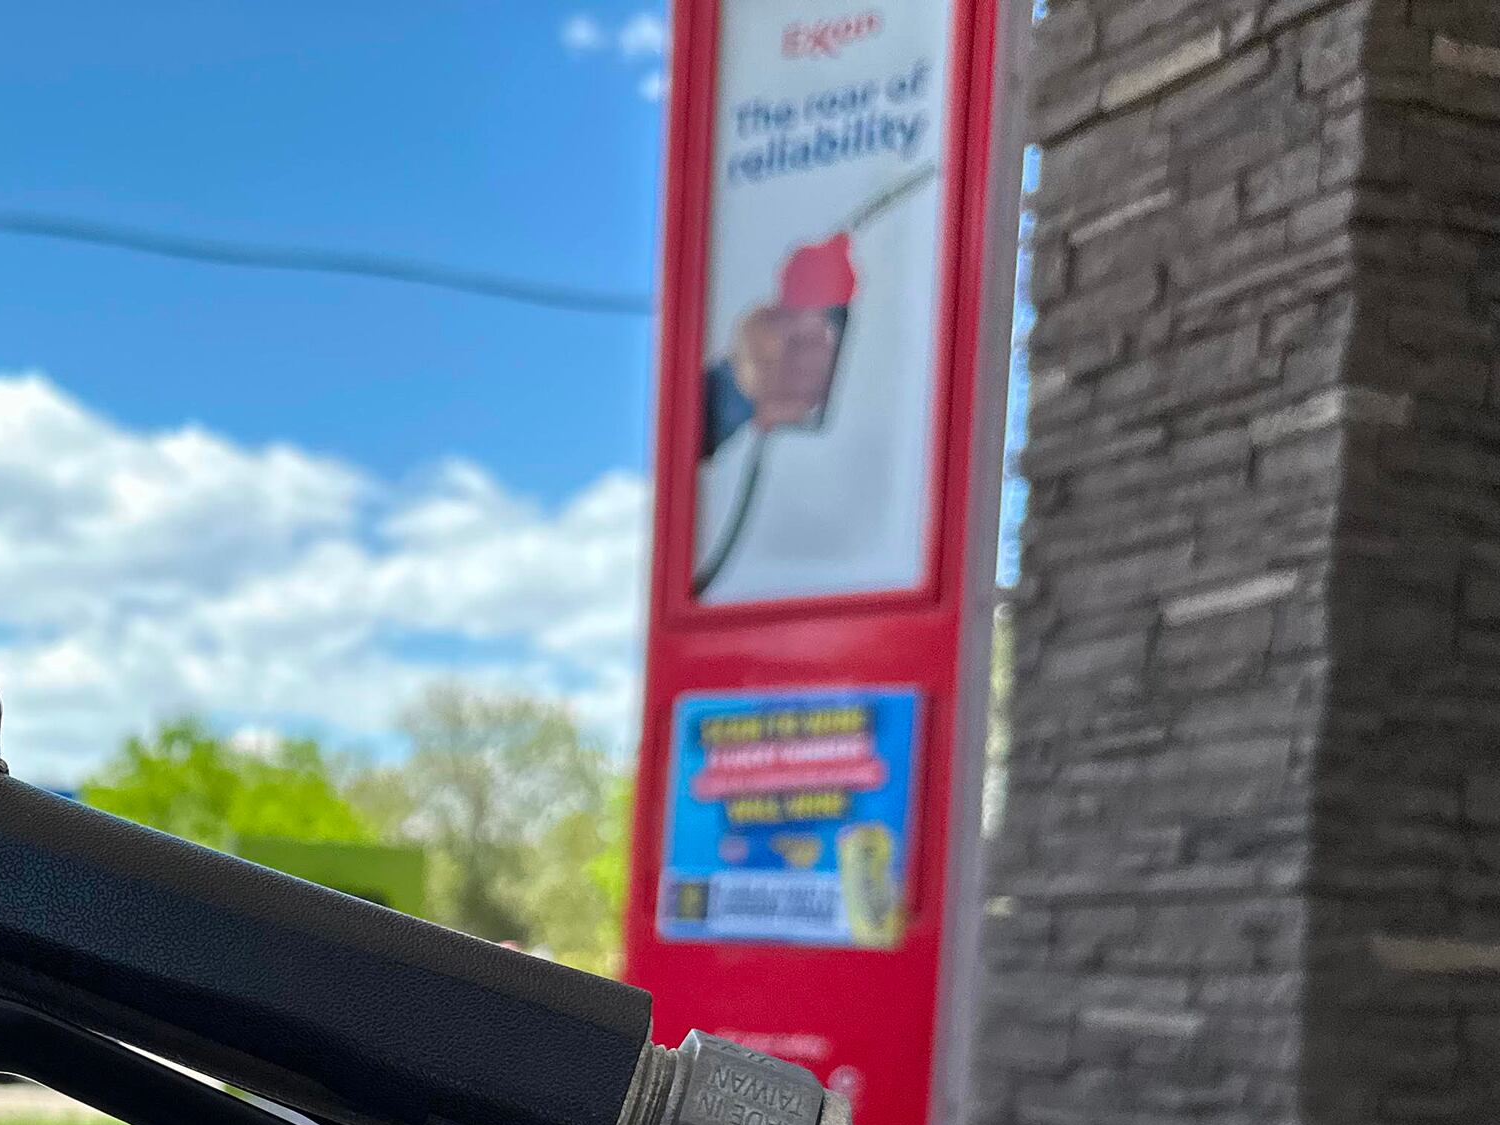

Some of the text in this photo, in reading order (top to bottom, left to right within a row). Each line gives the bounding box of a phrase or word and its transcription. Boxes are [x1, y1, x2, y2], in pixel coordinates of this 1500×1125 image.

[885, 56, 931, 103] of
[727, 113, 929, 189] reliability
[699, 1091, 724, 1118] IN
[710, 1065, 803, 1117] TAIWAN
